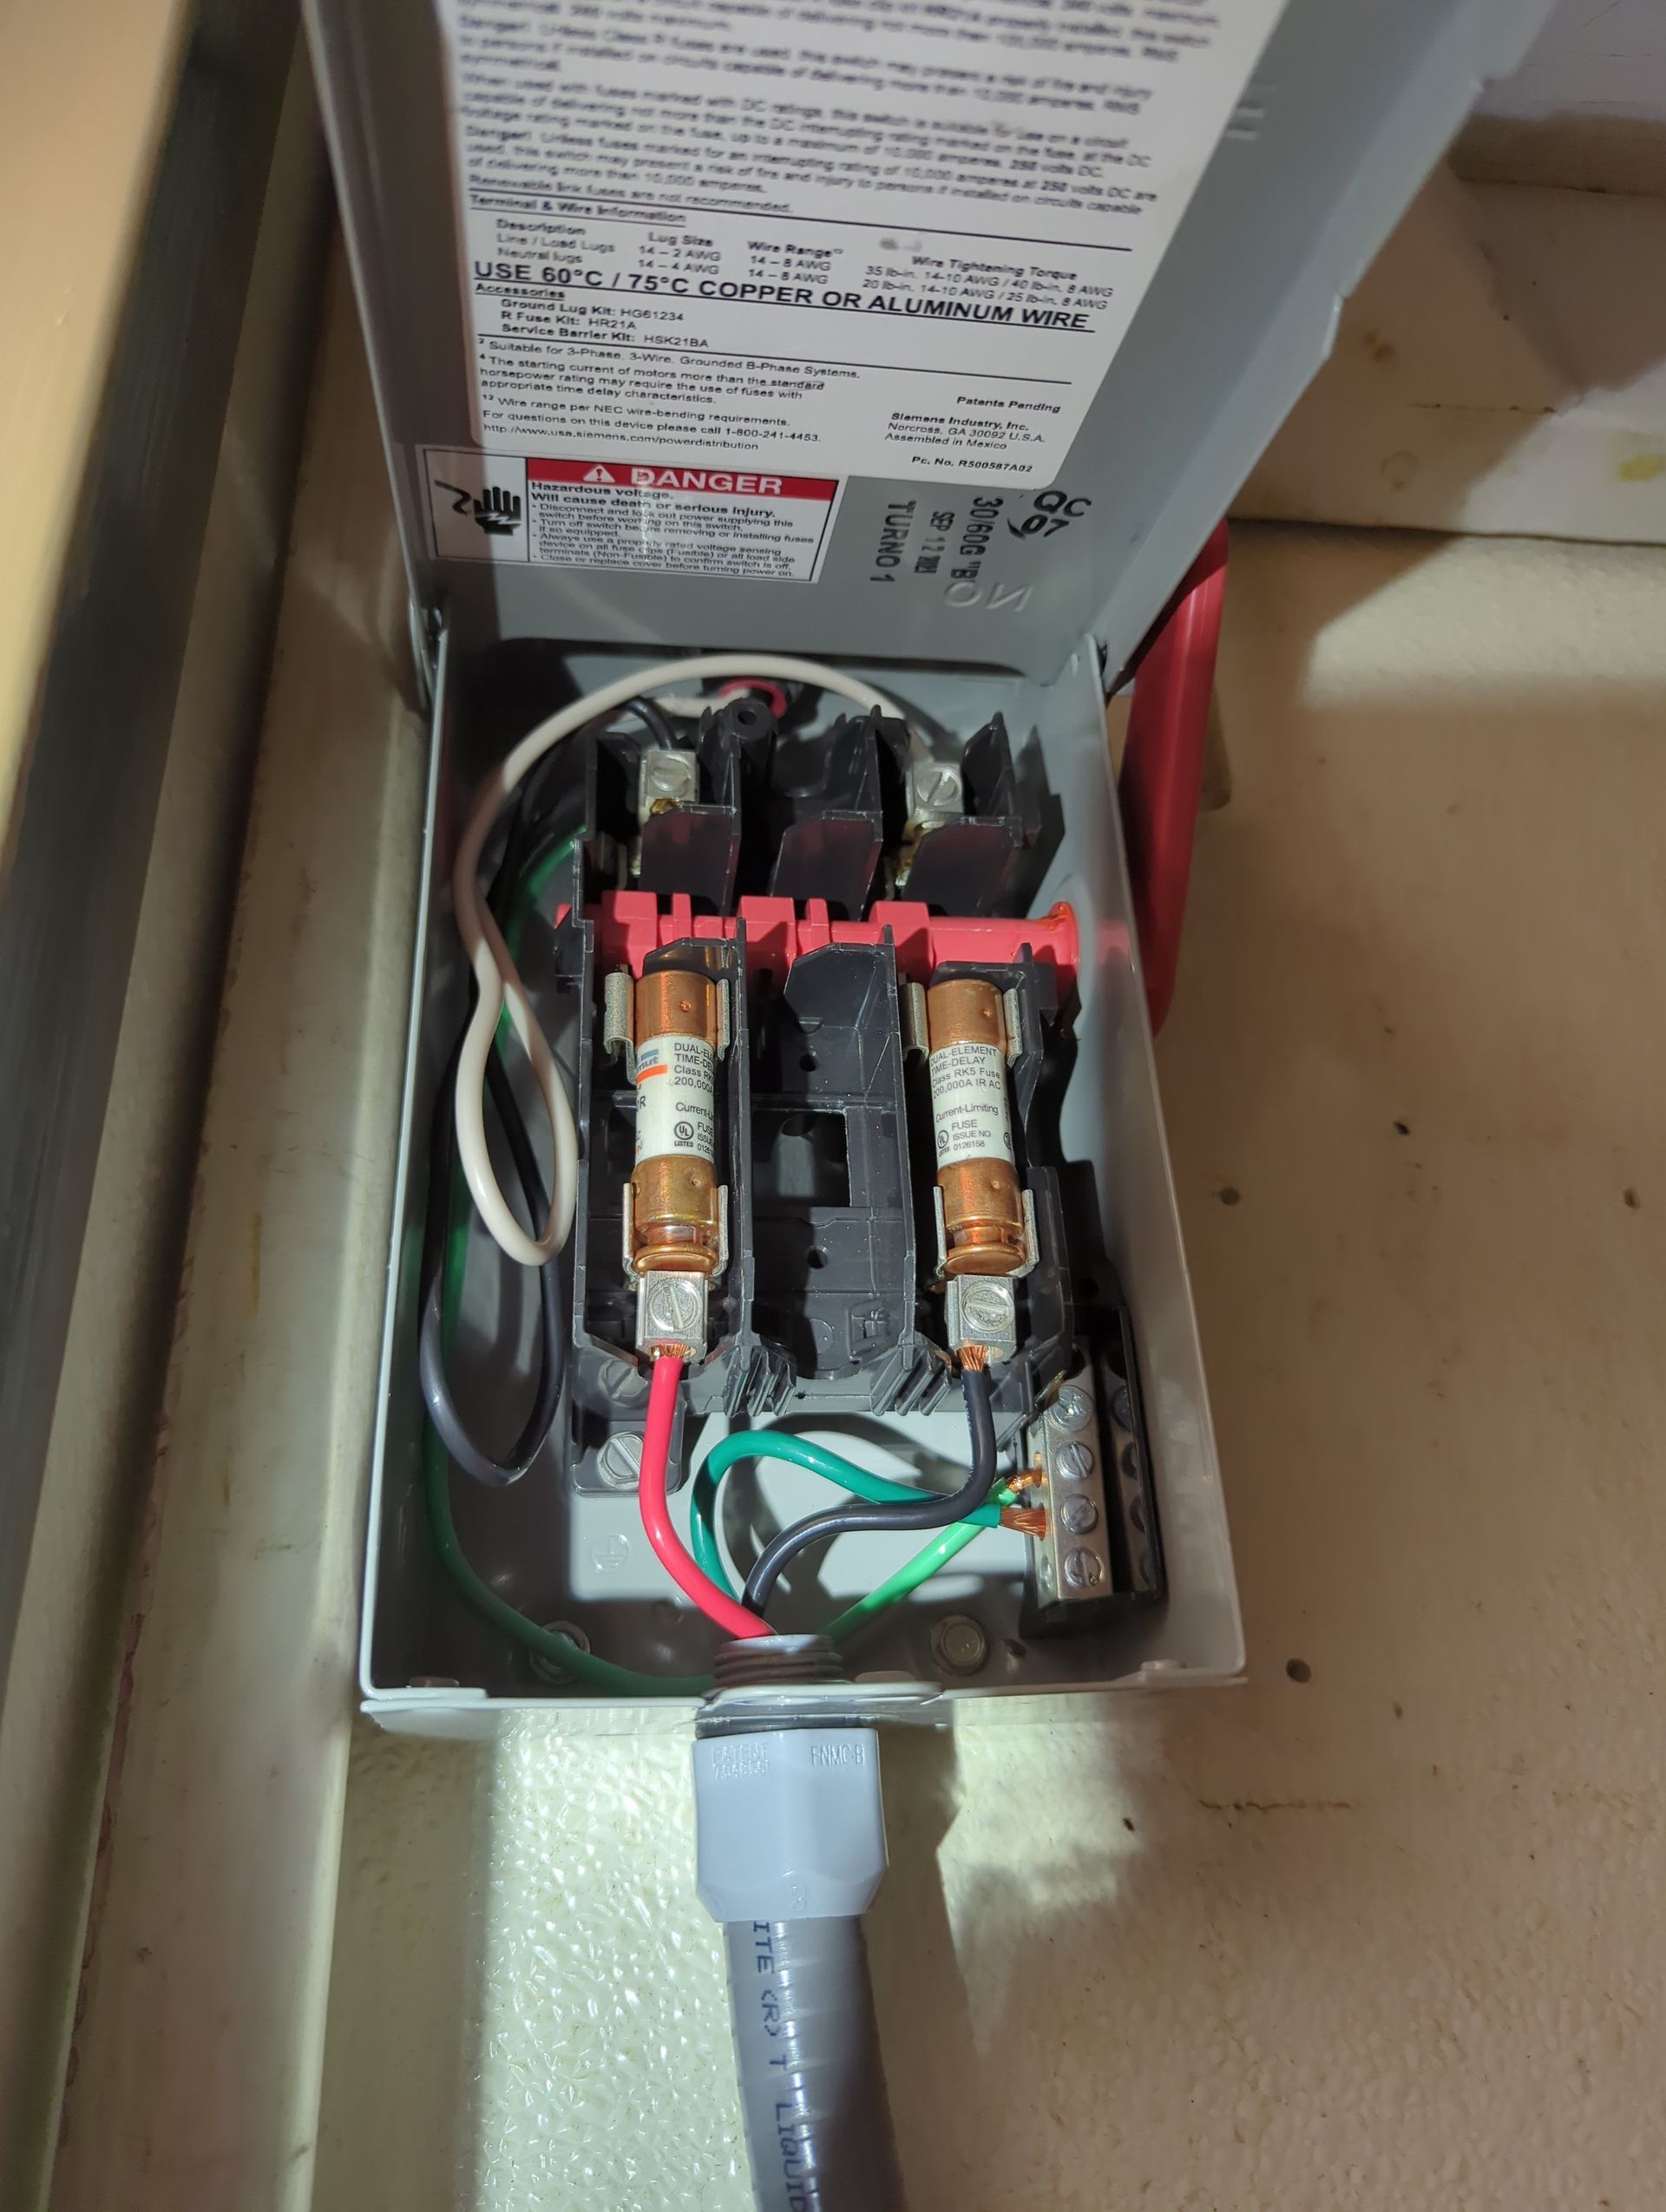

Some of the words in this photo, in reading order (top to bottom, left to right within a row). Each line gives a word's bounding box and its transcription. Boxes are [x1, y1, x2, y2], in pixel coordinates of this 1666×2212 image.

[495, 219, 586, 234] Description
[496, 233, 528, 245] Line
[541, 238, 576, 249] Load
[580, 242, 615, 253] Lugs
[647, 232, 678, 245] Lug
[681, 235, 713, 246] Size
[747, 241, 781, 252] Wire
[639, 245, 655, 254] 14
[685, 250, 721, 261] AWG
[683, 264, 719, 274] AWG
[751, 255, 766, 264] 14
[795, 260, 831, 271] AWG
[912, 256, 944, 267] Wire
[949, 259, 1025, 277] Tightening
[1030, 266, 1078, 279] Torque
[792, 273, 828, 284] AWG
[865, 265, 883, 276] 35
[925, 272, 961, 283] 14-10
[963, 275, 1000, 286] AWG
[1011, 279, 1029, 289] 40
[1078, 285, 1113, 297] AWG
[475, 262, 532, 280] USE
[541, 267, 602, 286] 60°C
[631, 275, 688, 293] 75°C
[699, 281, 813, 304] COPPER
[822, 291, 862, 309] OR
[868, 297, 1013, 321] ALUMINUM
[1022, 309, 1090, 329] WIRE
[476, 284, 567, 298] Accessories
[862, 278, 879, 289] 20
[921, 285, 957, 296] 14-10
[1006, 291, 1023, 302] 25
[501, 298, 555, 311] Ground
[559, 300, 587, 316] Lug
[591, 306, 615, 315] Kit:
[620, 309, 684, 320] HG61234
[501, 311, 512, 319] R
[516, 311, 551, 323] Fuse
[555, 316, 580, 324] Kit:
[588, 318, 636, 329] HR21A
[502, 324, 554, 335] Service
[558, 328, 607, 339] Barrier
[611, 332, 634, 342] Kit:
[644, 336, 708, 347] HSK21BA
[489, 341, 542, 352] Suitable
[546, 345, 563, 354] for
[679, 356, 743, 368] Grounded
[745, 361, 800, 373] B-Phase
[803, 366, 859, 378] Systems.
[489, 356, 514, 366] The
[518, 360, 565, 371] starting
[568, 364, 614, 373] current
[633, 370, 677, 378] motors
[716, 374, 744, 383] than
[747, 377, 767, 386] the
[769, 380, 825, 389] standard
[480, 369, 555, 380] horsepower
[559, 375, 594, 385] rating
[598, 377, 626, 387] may
[628, 380, 672, 389] require
[677, 383, 696, 391] the
[741, 387, 774, 397] fuses
[481, 381, 553, 391] appropriate
[556, 385, 583, 394] time
[587, 387, 621, 397] delay
[625, 390, 717, 402] characteristics.
[497, 397, 527, 406] Wire
[530, 402, 566, 410] range
[594, 404, 623, 414] NEC
[626, 409, 705, 421] wire-bending
[709, 415, 790, 425] requirements.
[956, 396, 1005, 407] Patents
[1008, 401, 1060, 413] Pending
[482, 409, 503, 418] For
[508, 414, 566, 423] questions
[614, 420, 653, 429] device
[657, 423, 697, 432] please
[891, 413, 945, 423] Siemens
[948, 417, 1002, 429] Industry,
[1006, 422, 1028, 430] Inc.
[884, 433, 949, 444] Assembled
[966, 439, 1007, 449] Mexico
[968, 429, 1006, 439] 30092
[531, 481, 611, 494] Hazardous
[630, 468, 783, 494] DANGER
[531, 493, 559, 501] Will
[563, 496, 607, 505] cause
[674, 504, 728, 514] serious
[732, 507, 775, 518] injury.
[1033, 489, 1092, 518] QC
[930, 511, 954, 532] SEP
[960, 497, 1003, 555] 30/60G
[876, 501, 916, 567] TURNO
[930, 1046, 997, 1065] DUAL-ELEMENT
[674, 1064, 701, 1077] Class
[932, 1057, 986, 1074] TIME-DELAY
[932, 1074, 950, 1088] Class
[954, 1068, 976, 1077] RK5
[980, 1069, 1000, 1079] Fuse
[933, 1078, 973, 1099] 200,000A
[976, 1078, 986, 1087] IR
[989, 1081, 1001, 1090] AC
[935, 1103, 999, 1122] Current-Limiting
[952, 1119, 978, 1131] FUSE
[953, 1130, 977, 1141] ISSUE
[954, 1140, 985, 1150] 0126158
